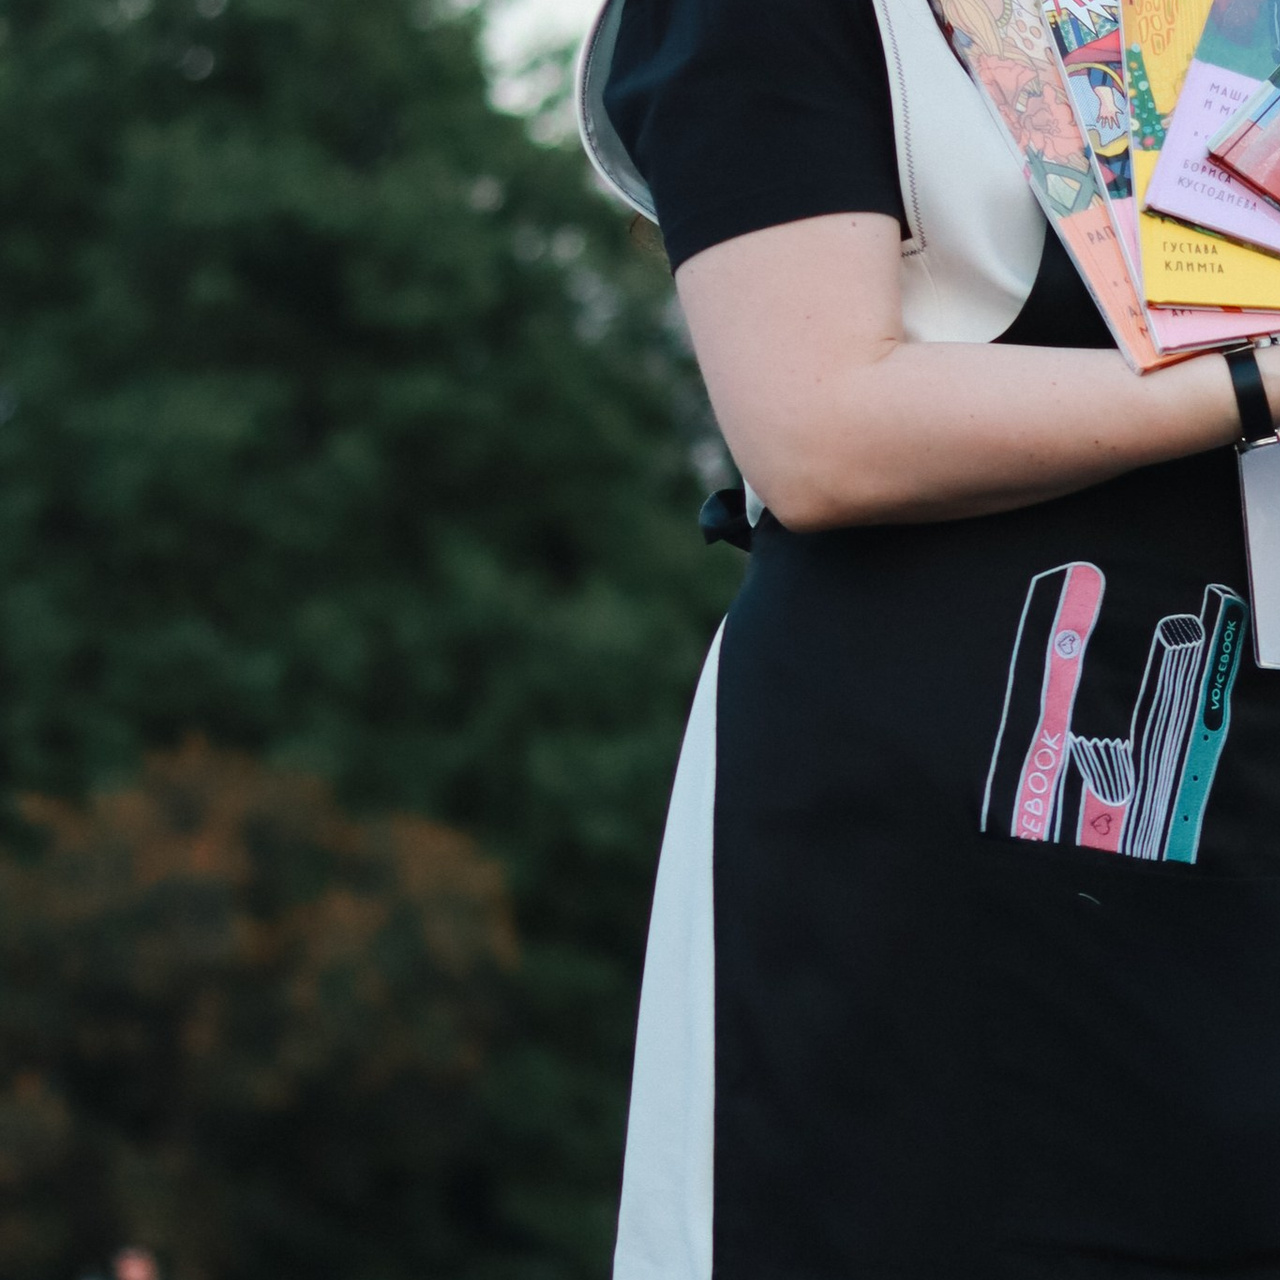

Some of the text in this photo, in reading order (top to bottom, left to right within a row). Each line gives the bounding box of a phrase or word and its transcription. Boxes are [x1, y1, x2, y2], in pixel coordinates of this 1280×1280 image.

[1182, 158, 1233, 184] БОРИСА
[1177, 176, 1258, 212] КУСТОДИЕВА
[1162, 241, 1219, 255] ГУСТАВА
[1164, 260, 1225, 274] КЛИМТА
[1211, 620, 1237, 710] VOICEBOOK
